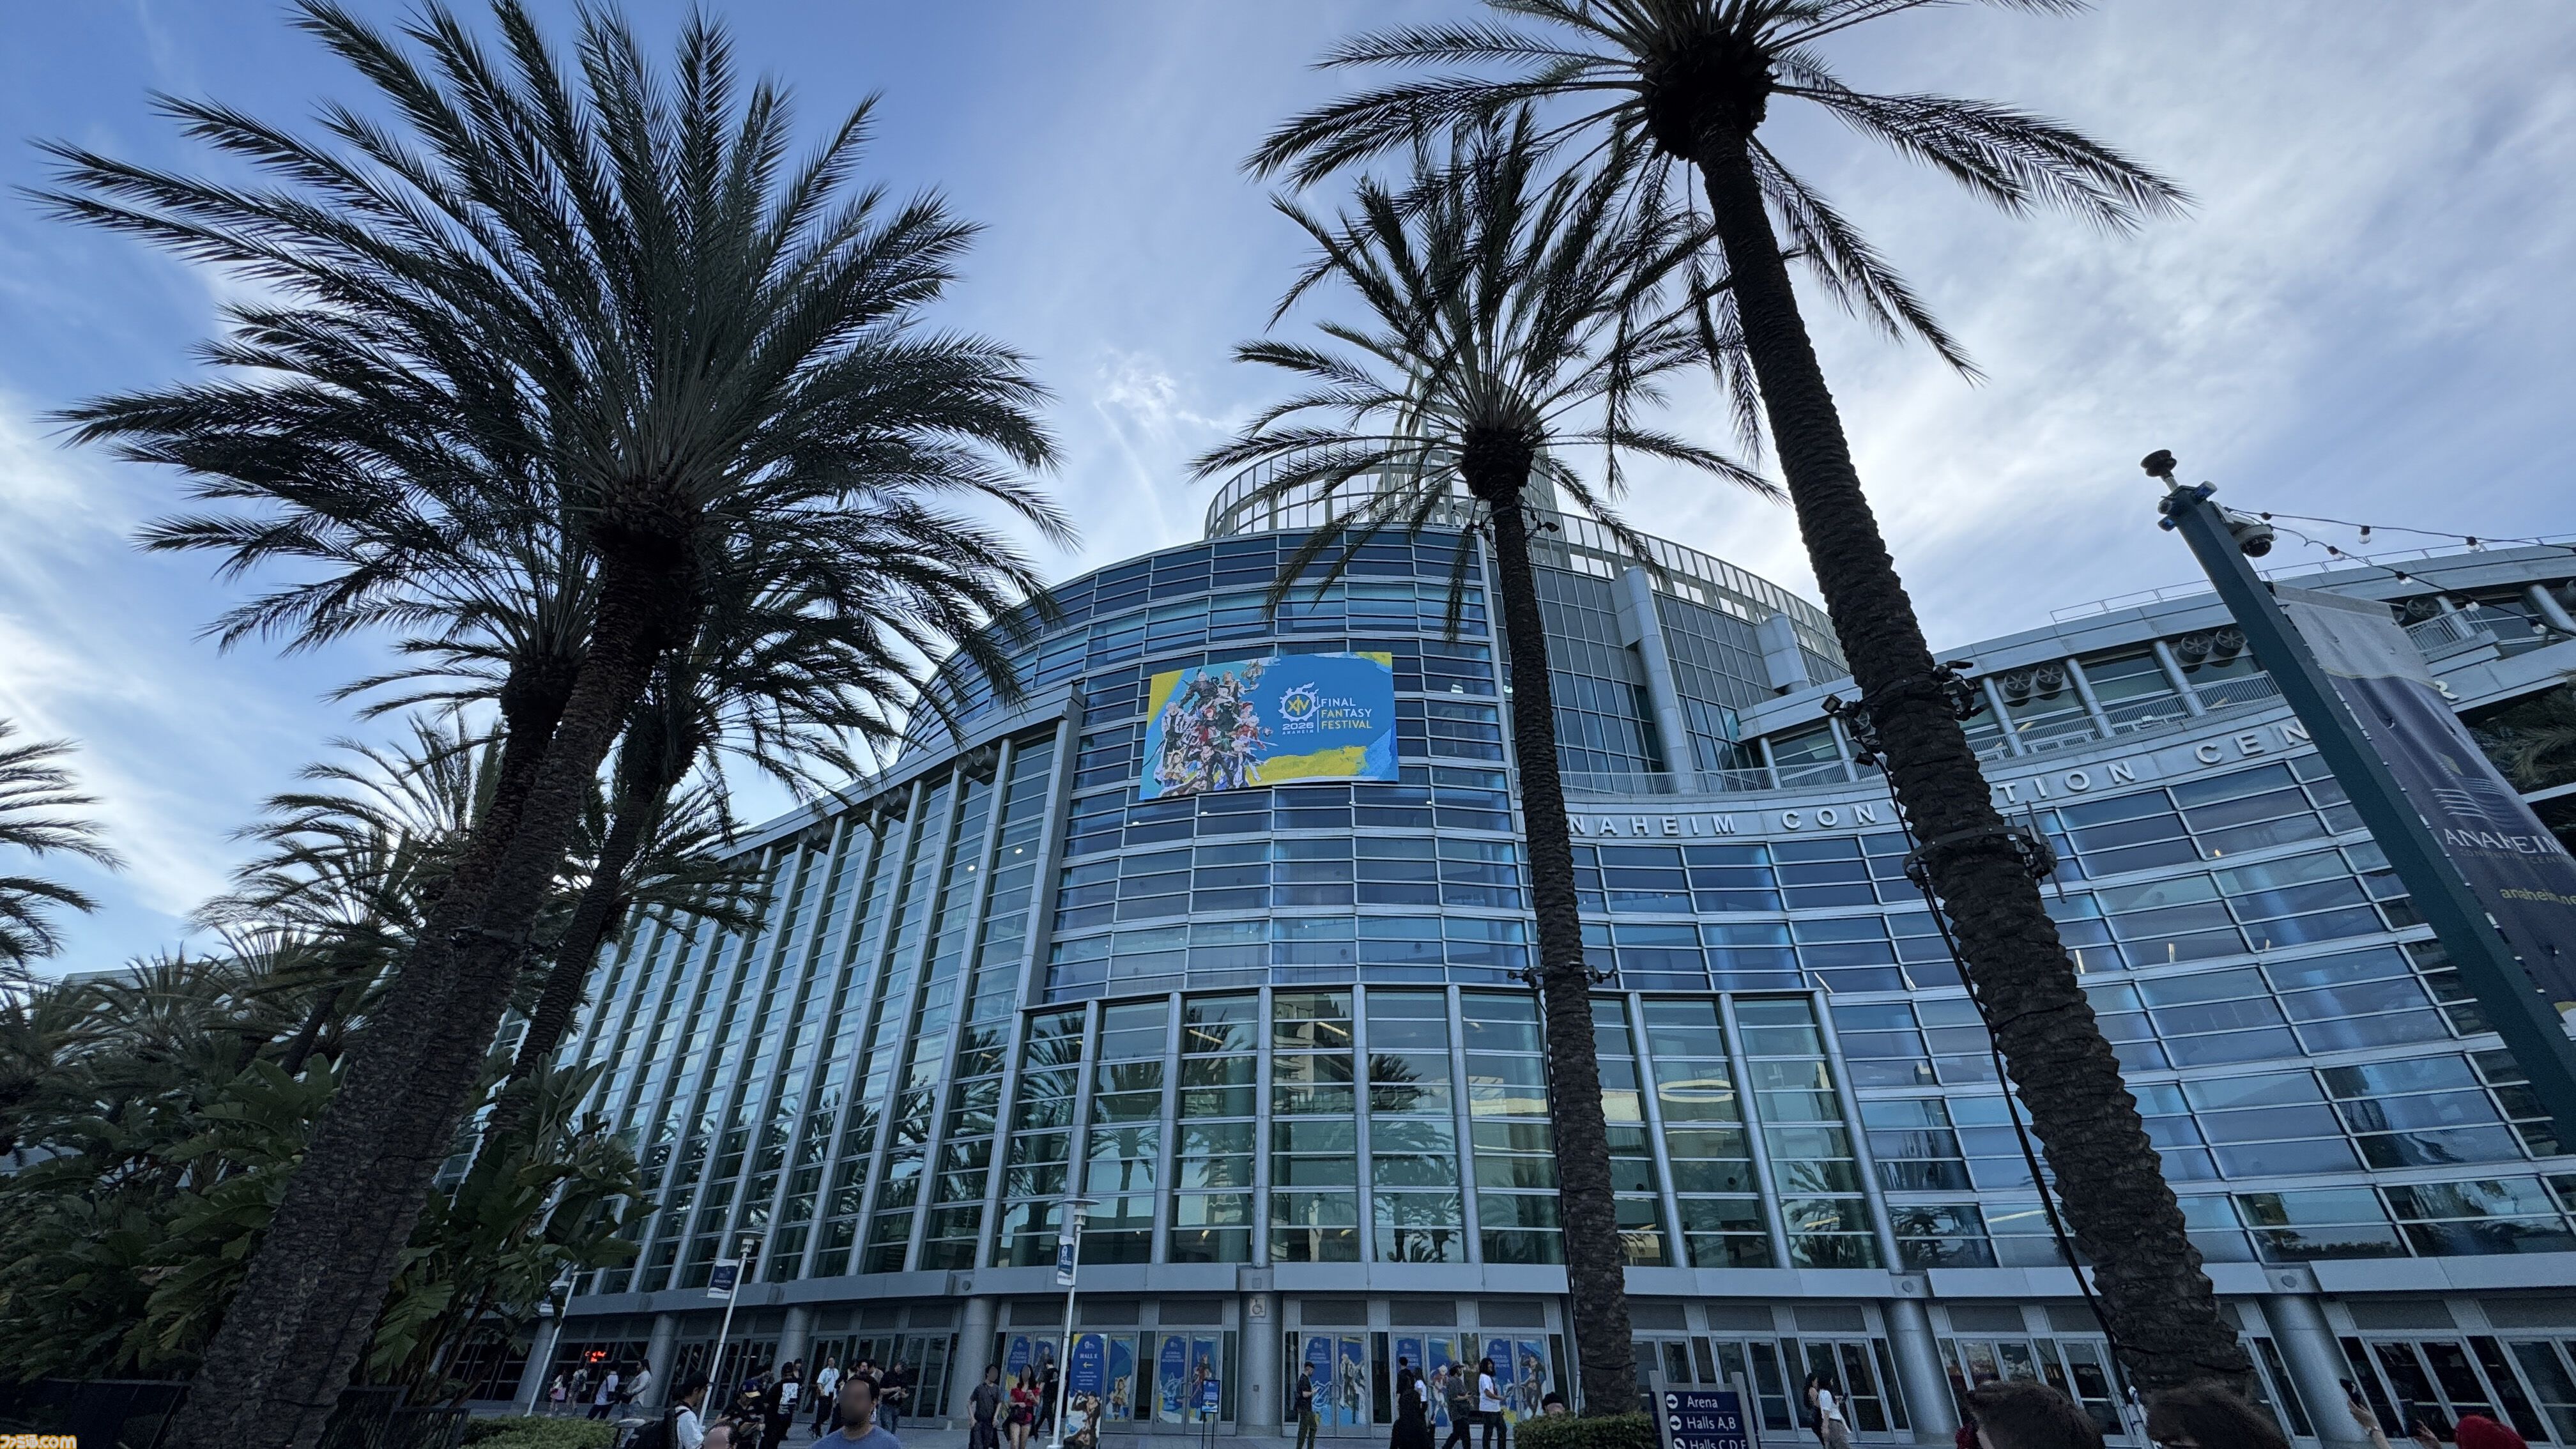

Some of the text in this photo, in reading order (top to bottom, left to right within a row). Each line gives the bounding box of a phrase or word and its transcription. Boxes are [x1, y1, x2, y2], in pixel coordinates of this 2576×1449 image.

[1321, 698, 1356, 707] FINAL
[1321, 709, 1372, 718] FANTASY
[1282, 722, 1314, 730] 2026
[1321, 719, 1373, 730] FESTIVAL
[1567, 813, 1736, 835] NAHEIM
[1687, 1395, 1718, 1408] Arena
[1687, 1415, 1736, 1431] Halls A,B
[1689, 1439, 1716, 1449] Halls
